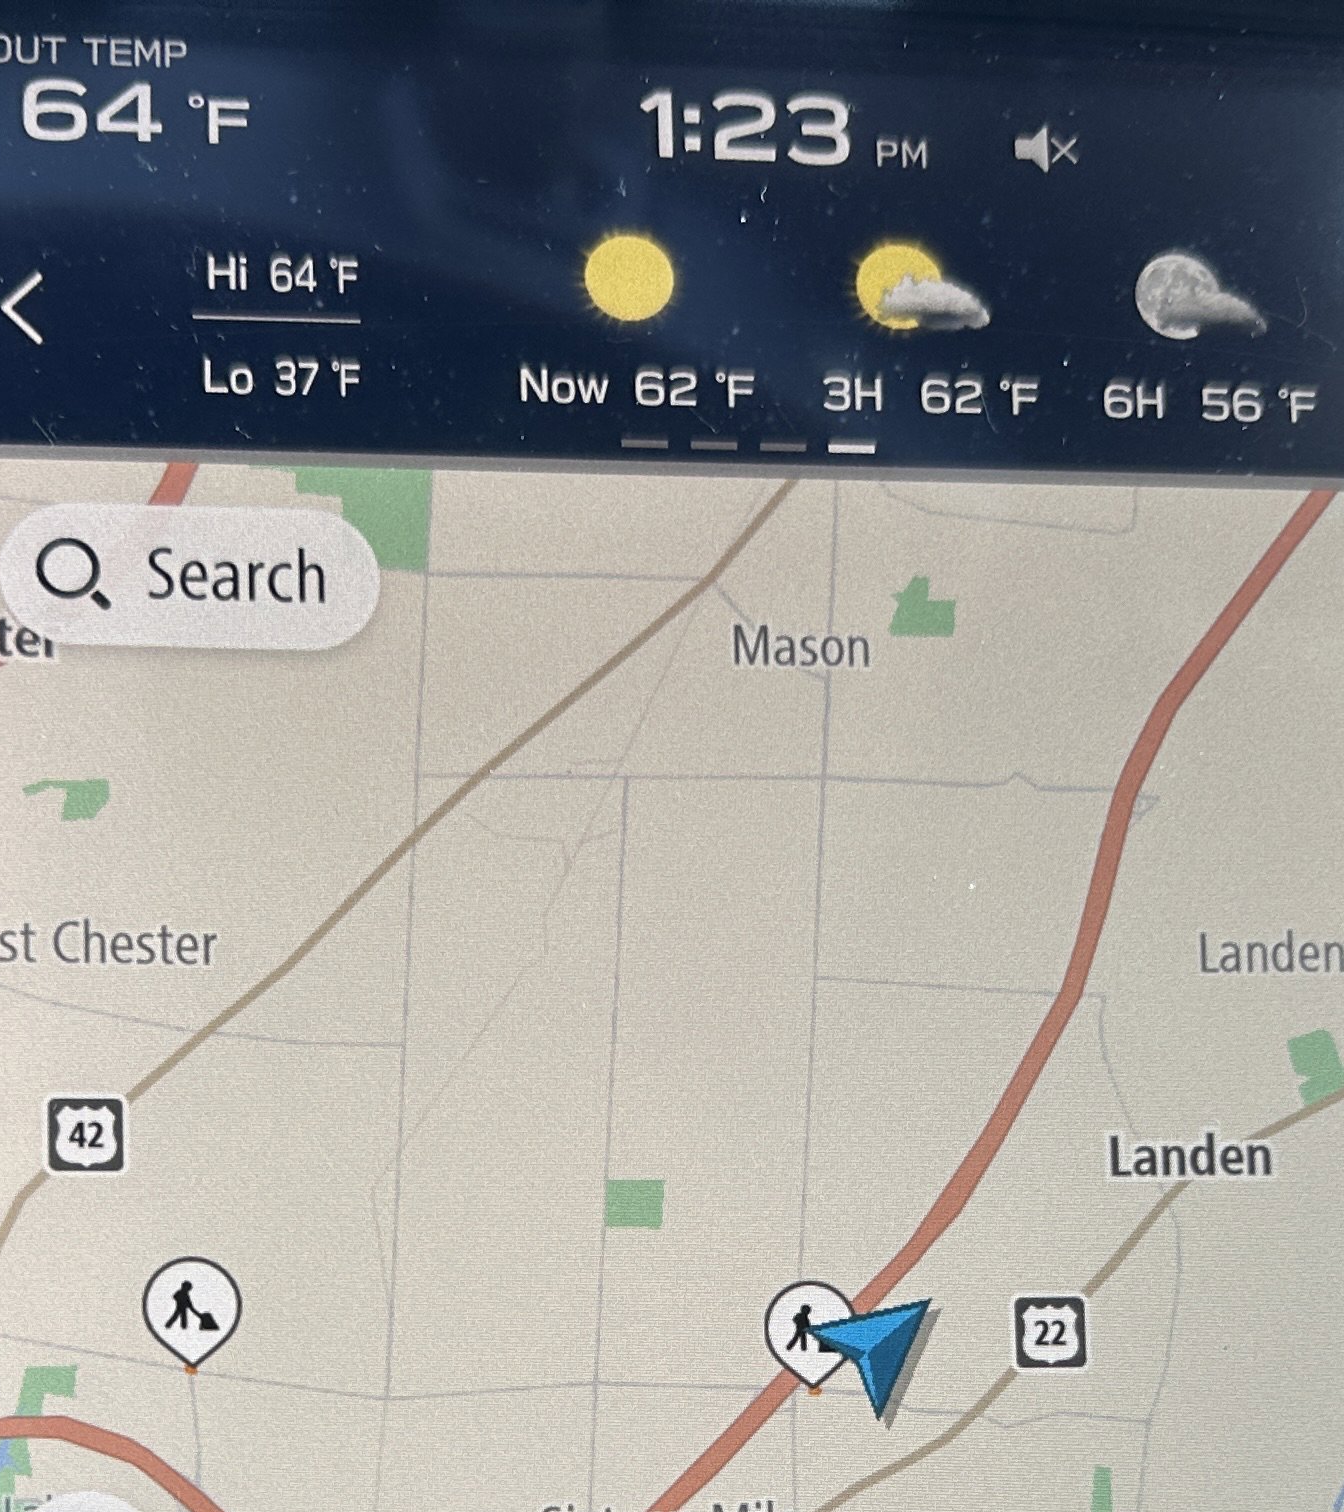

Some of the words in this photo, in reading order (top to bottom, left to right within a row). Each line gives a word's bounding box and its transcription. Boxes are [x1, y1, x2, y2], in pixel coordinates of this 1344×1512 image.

[83, 37, 188, 69] TEMP
[21, 79, 163, 143] 64
[188, 93, 251, 144] °F
[639, 89, 852, 168] 1:23
[876, 139, 928, 170] PM
[206, 255, 248, 291] Hi
[269, 257, 318, 293] 64
[329, 258, 358, 294] °F
[203, 359, 255, 395] Lo
[274, 361, 319, 397] 37
[332, 362, 361, 398] °F
[519, 368, 609, 405] Now
[634, 371, 698, 407] 62
[715, 371, 755, 408] °F
[823, 376, 883, 413] 3H
[921, 378, 982, 416] 62
[999, 380, 1039, 416] °F
[1102, 384, 1165, 420] 6H
[1201, 386, 1262, 423] 56
[1278, 389, 1316, 423] °F
[148, 547, 326, 603] Search
[732, 625, 870, 668] Mason
[53, 918, 217, 965] Chester
[68, 1122, 105, 1148] 42
[1109, 1133, 1273, 1179] Landen
[1035, 1319, 1066, 1347] 22
